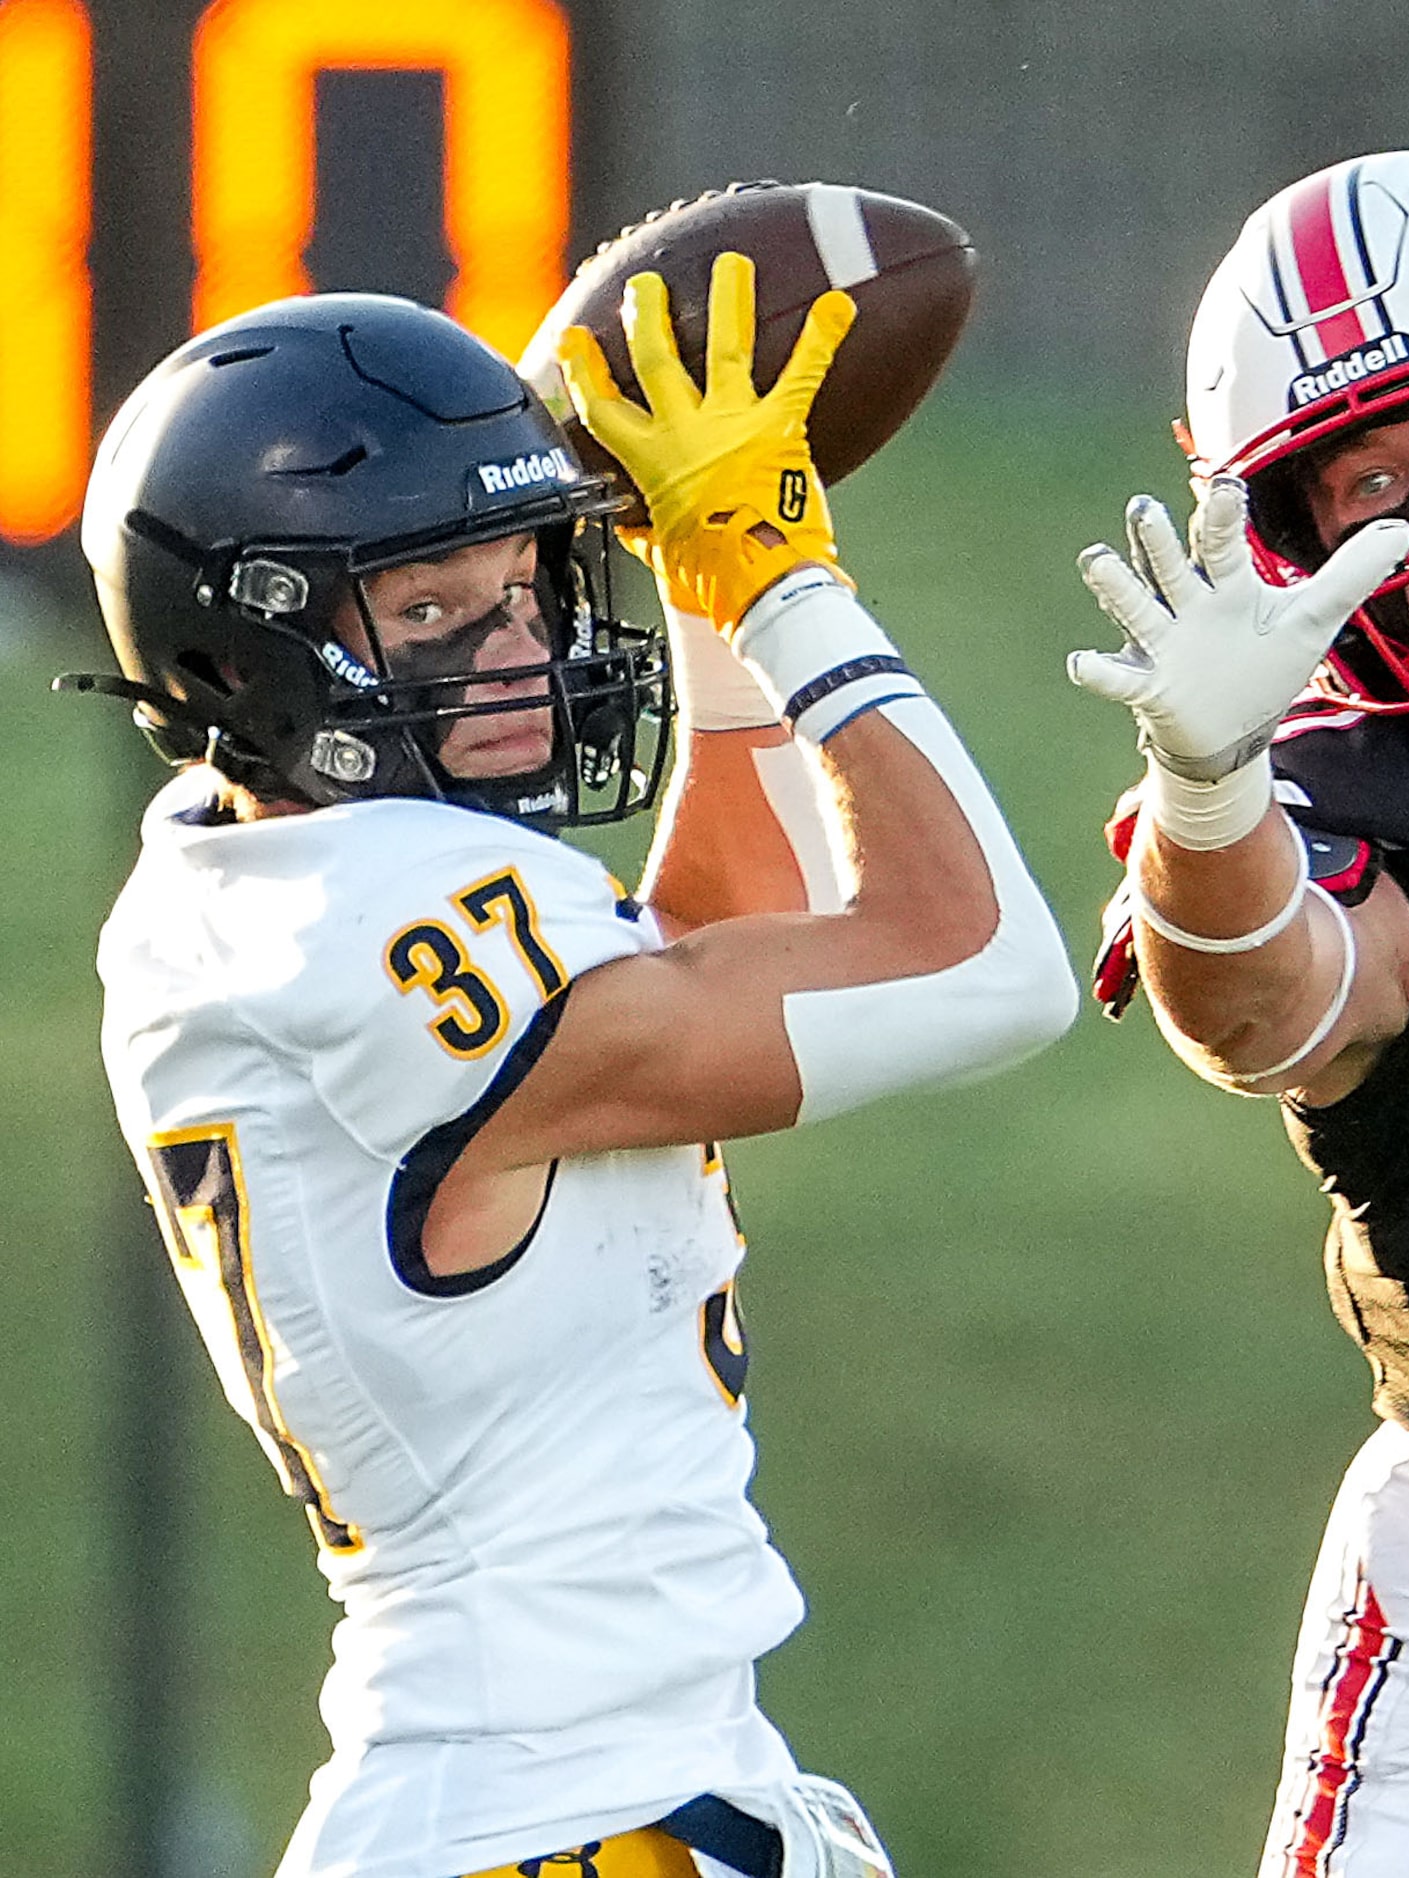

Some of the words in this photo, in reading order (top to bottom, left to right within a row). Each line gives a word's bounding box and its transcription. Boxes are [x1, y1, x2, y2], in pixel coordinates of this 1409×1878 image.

[1291, 333, 1409, 406] Riddell
[478, 447, 577, 494] Riddell
[382, 862, 570, 1063] 37
